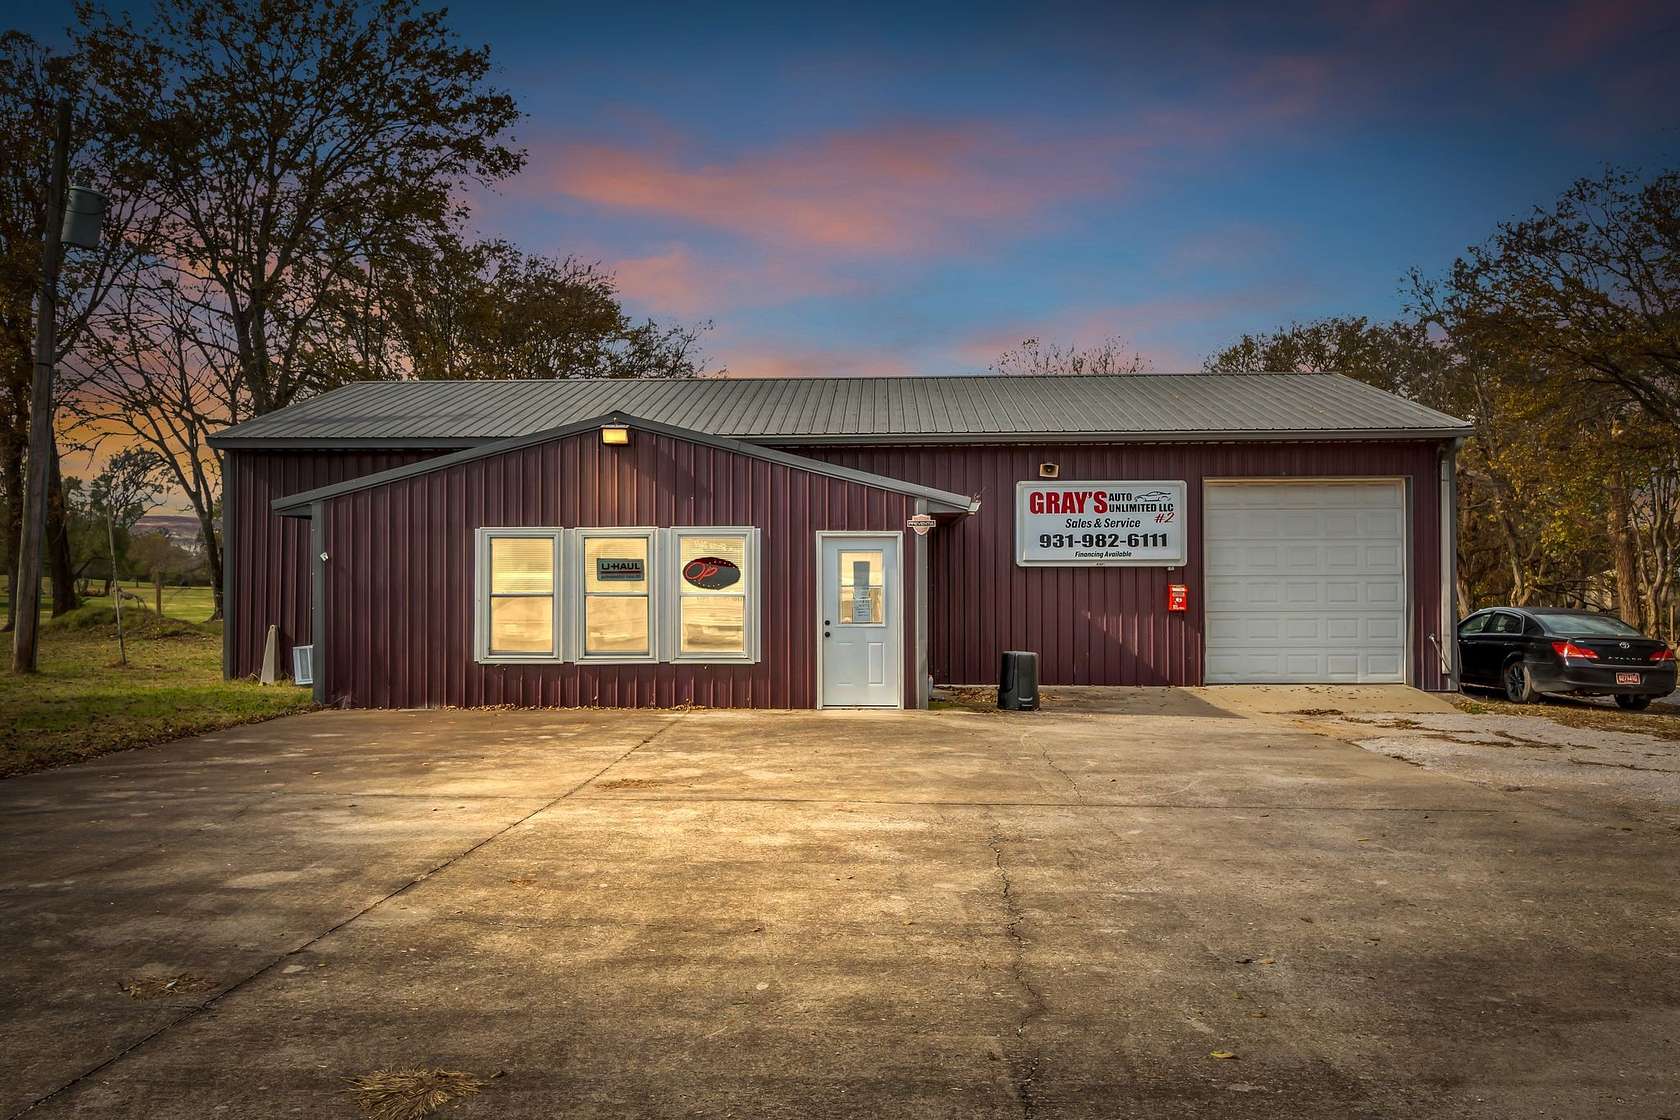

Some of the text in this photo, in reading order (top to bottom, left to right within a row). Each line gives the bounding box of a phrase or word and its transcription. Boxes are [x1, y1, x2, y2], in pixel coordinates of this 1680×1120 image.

[1029, 491, 1108, 514] GRAY'S
[1108, 492, 1133, 502] AUTO
[1108, 503, 1174, 513] UNLIMITED LLC
[1065, 517, 1141, 529] Sales & Service
[1153, 512, 1175, 524] #2
[1039, 533, 1168, 548] 931-982-6111
[601, 562, 641, 570] U-HAUL
